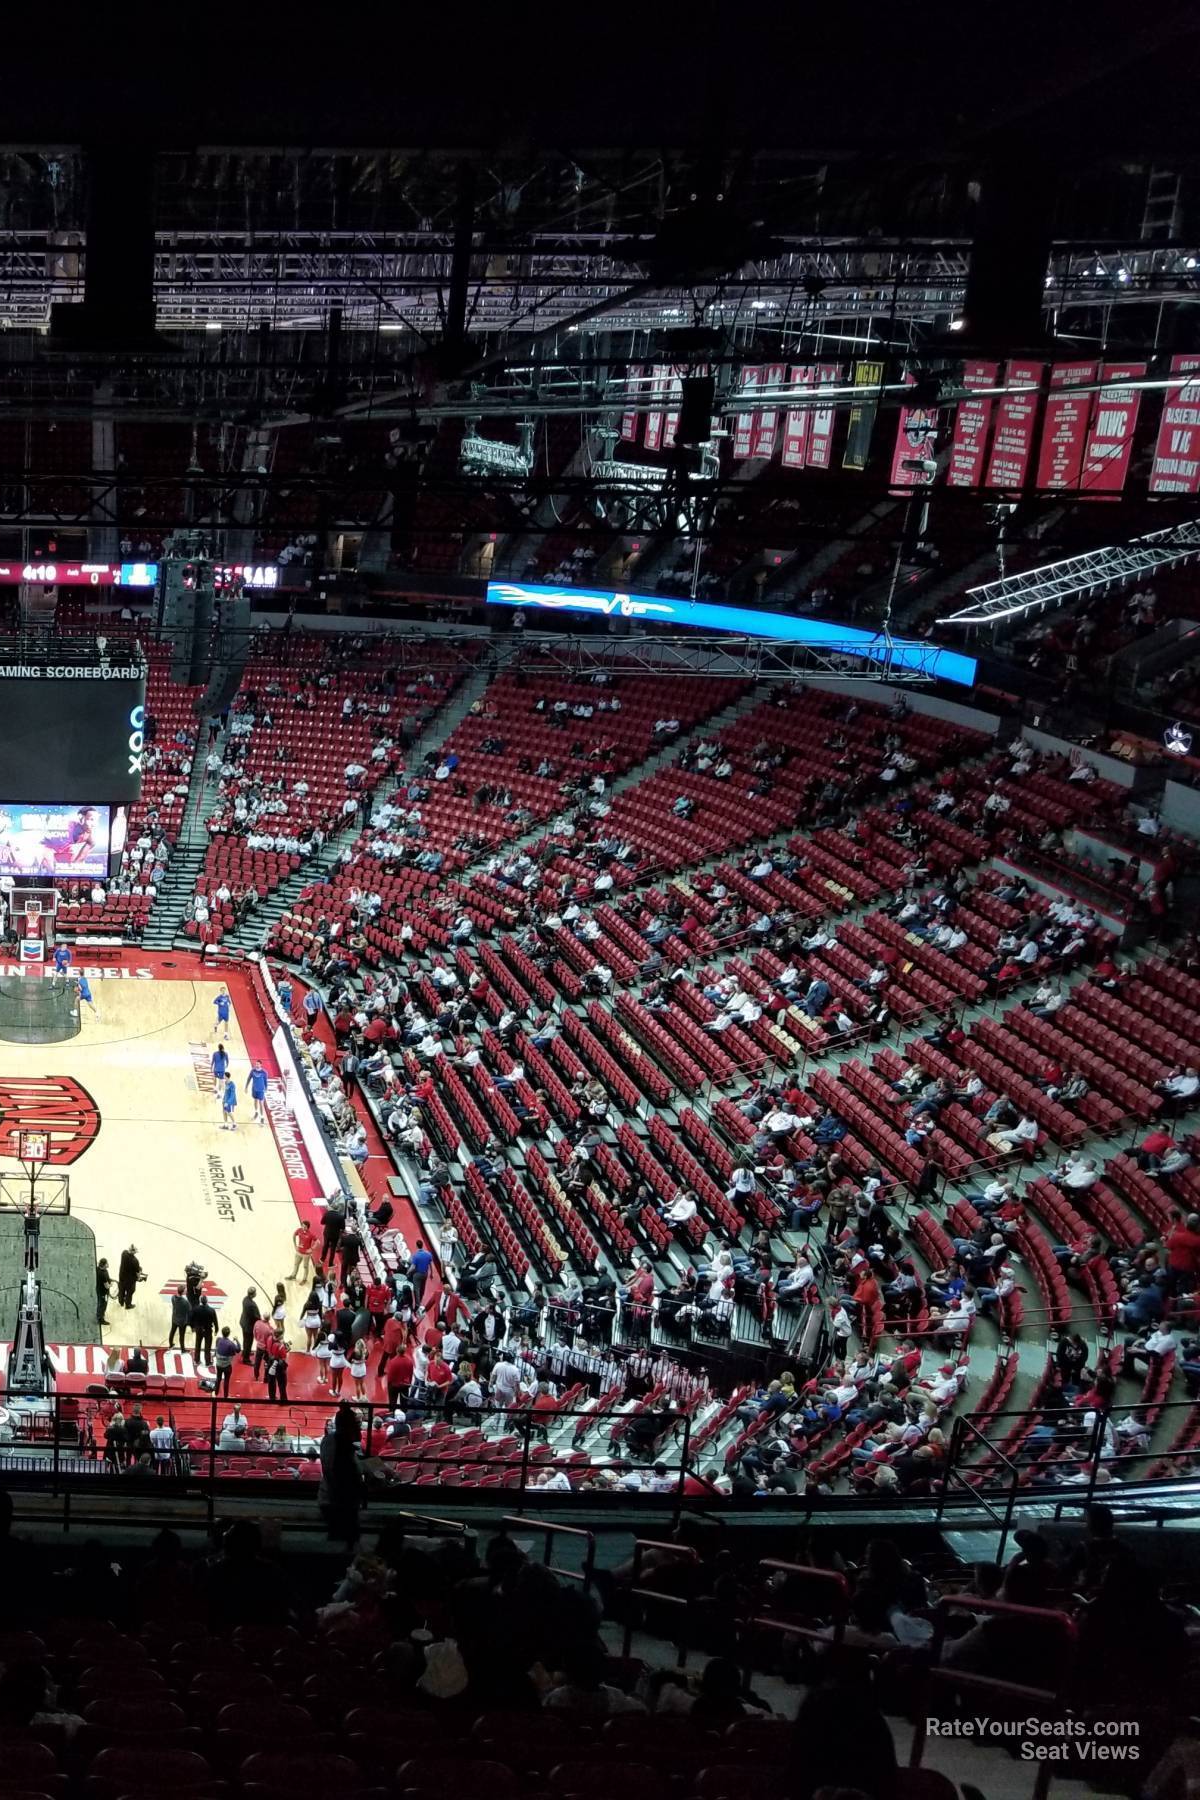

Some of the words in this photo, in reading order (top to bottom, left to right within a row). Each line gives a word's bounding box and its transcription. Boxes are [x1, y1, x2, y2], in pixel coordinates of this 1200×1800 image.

[1096, 411, 1127, 437] MWC
[23, 565, 57, 581] 4:10
[91, 573, 99, 584] 0
[46, 665, 140, 679] SCOREBOARD
[128, 705, 144, 774] COX
[272, 1121, 303, 1147] Mack
[283, 1147, 308, 1180] CENTER
[206, 1154, 226, 1193] AMERICA
[216, 1194, 236, 1222] FIRST
